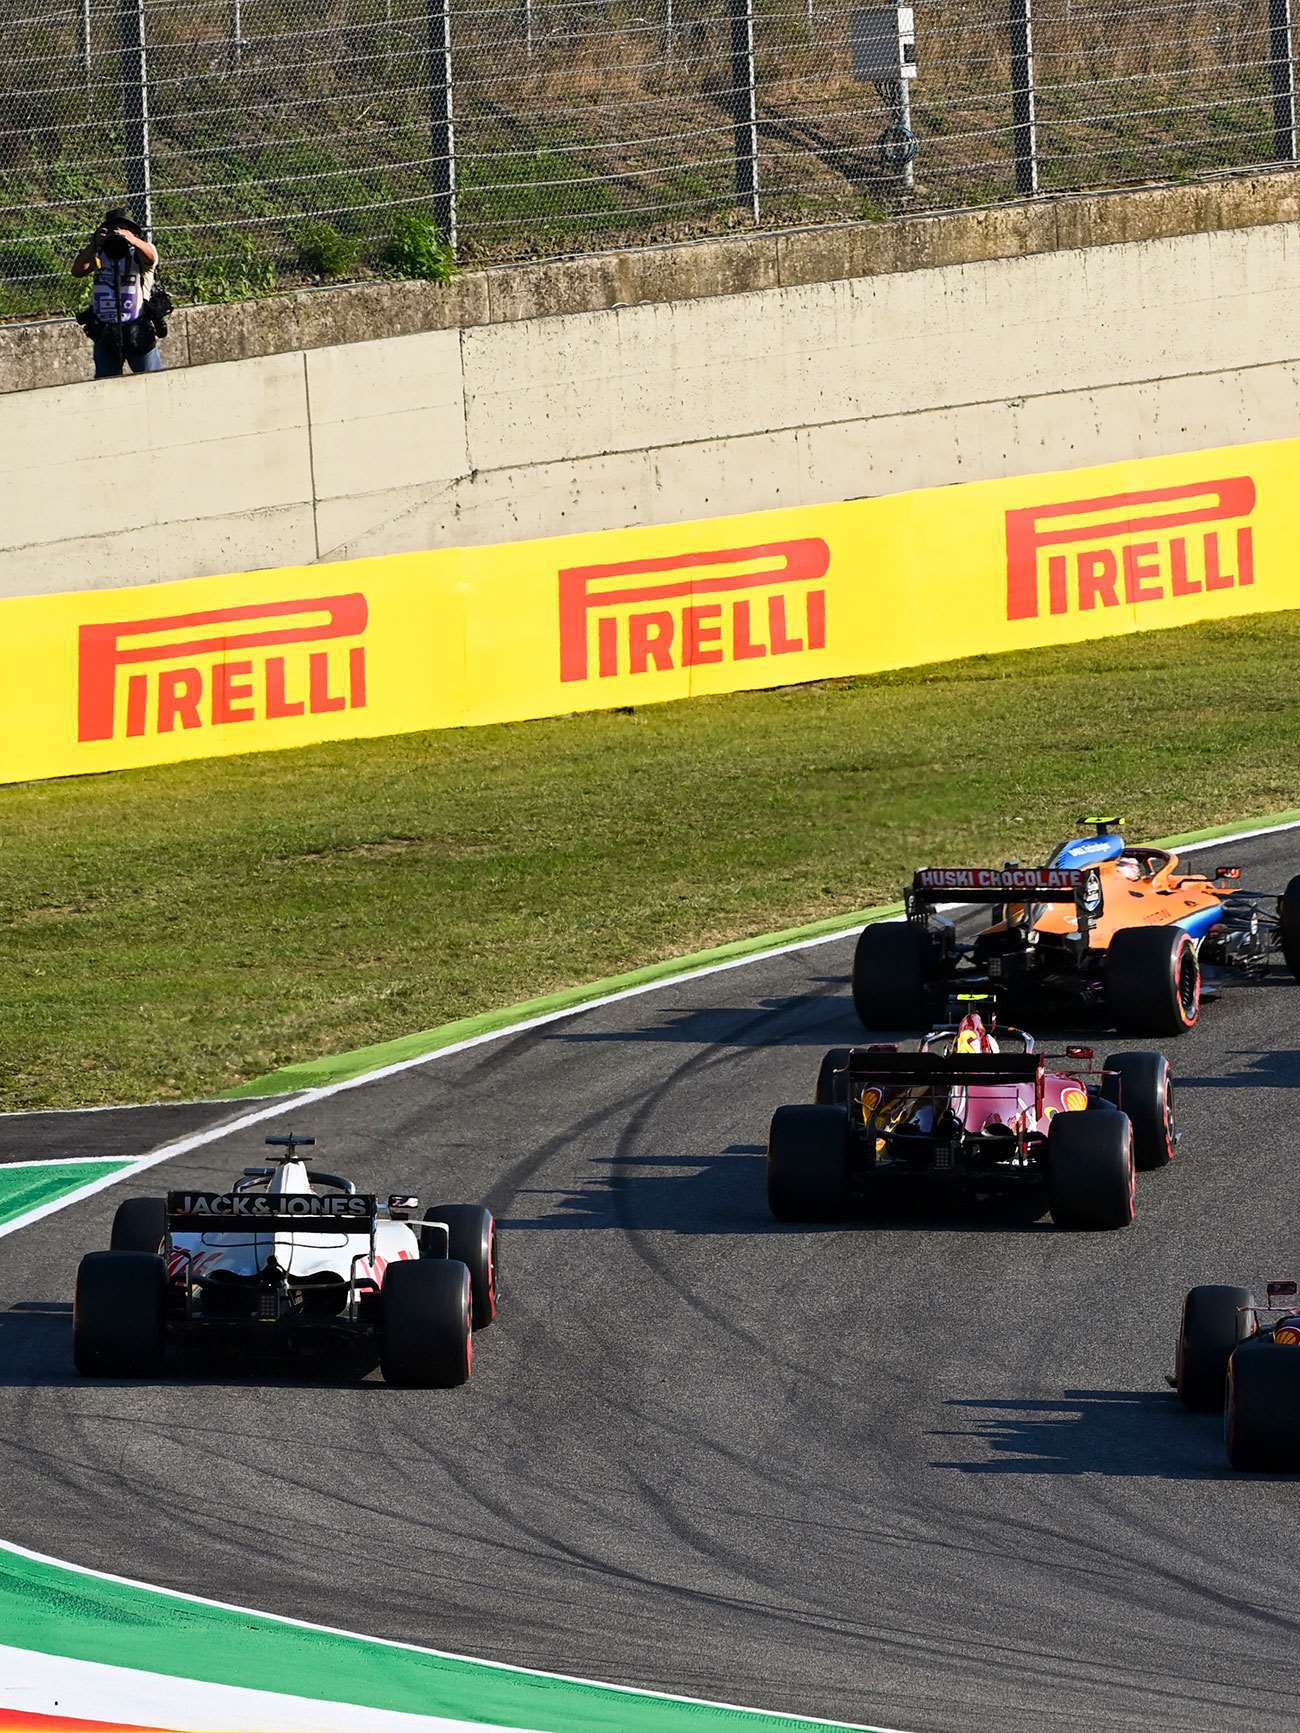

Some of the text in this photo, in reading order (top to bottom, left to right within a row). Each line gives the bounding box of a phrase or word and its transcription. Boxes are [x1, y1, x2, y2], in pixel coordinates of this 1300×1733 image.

[558, 537, 830, 683] PIRELLI
[1005, 476, 1256, 621] PIRELLI
[77, 592, 369, 743] PIRELLI
[921, 870, 1082, 887] HUSKI CHOCOLATE
